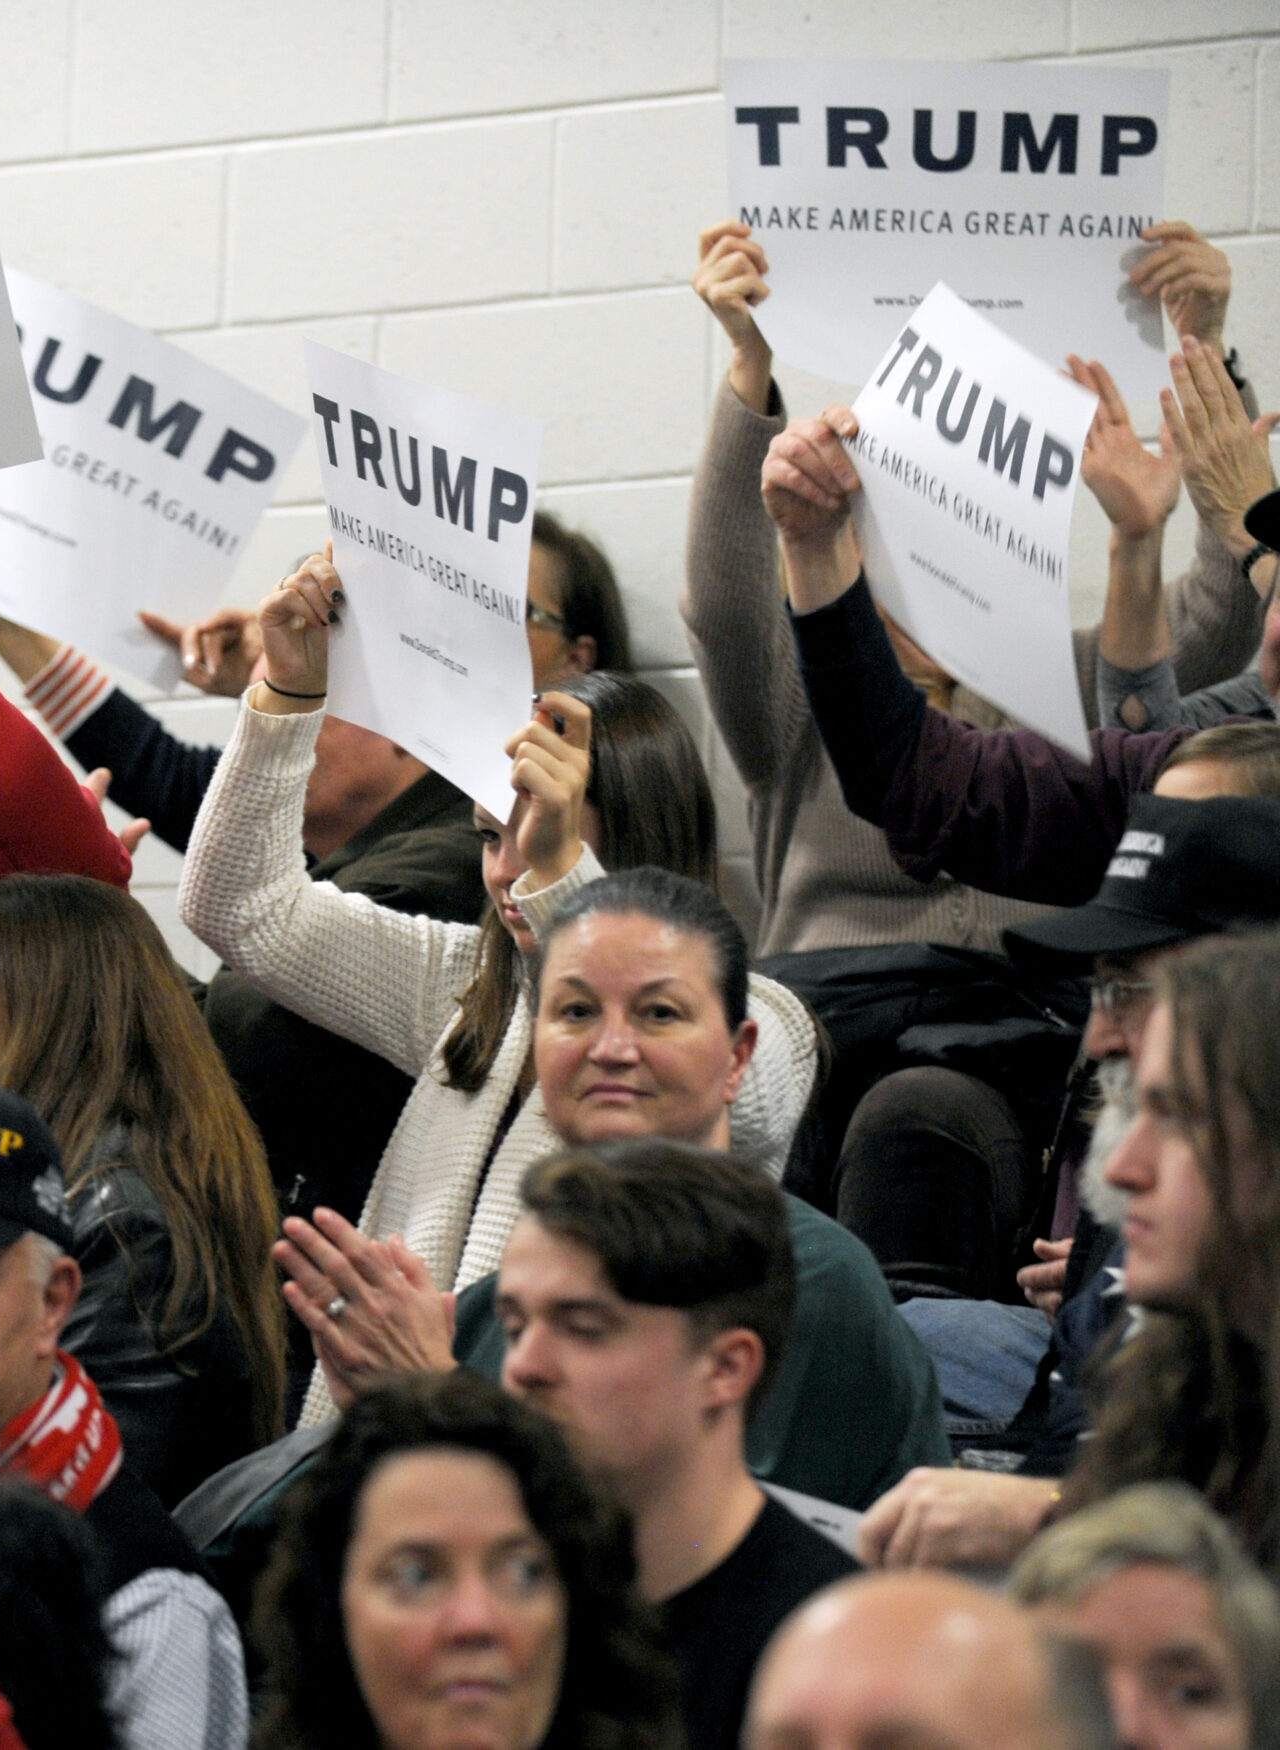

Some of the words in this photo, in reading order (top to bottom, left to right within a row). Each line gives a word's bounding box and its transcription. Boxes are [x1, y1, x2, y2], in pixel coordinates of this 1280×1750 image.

[735, 106, 1159, 176] TRUMP
[739, 206, 819, 231] MAKE
[829, 207, 953, 234] AMERICA
[964, 211, 1050, 237] GREAT
[15, 322, 277, 484] UMP
[312, 392, 529, 542] TRUMP
[875, 326, 1075, 505] TRUMP
[50, 444, 140, 497] GREAT
[140, 489, 240, 556] AGAIN!
[329, 504, 365, 545] MAKE
[368, 524, 428, 577] AMERICA
[428, 556, 470, 598] GREAT
[472, 578, 521, 626] AGAIN!
[840, 430, 877, 464] AKE
[879, 445, 948, 512] AMERICA
[953, 491, 1003, 547] GREAT
[1006, 526, 1063, 588] AGAIN!
